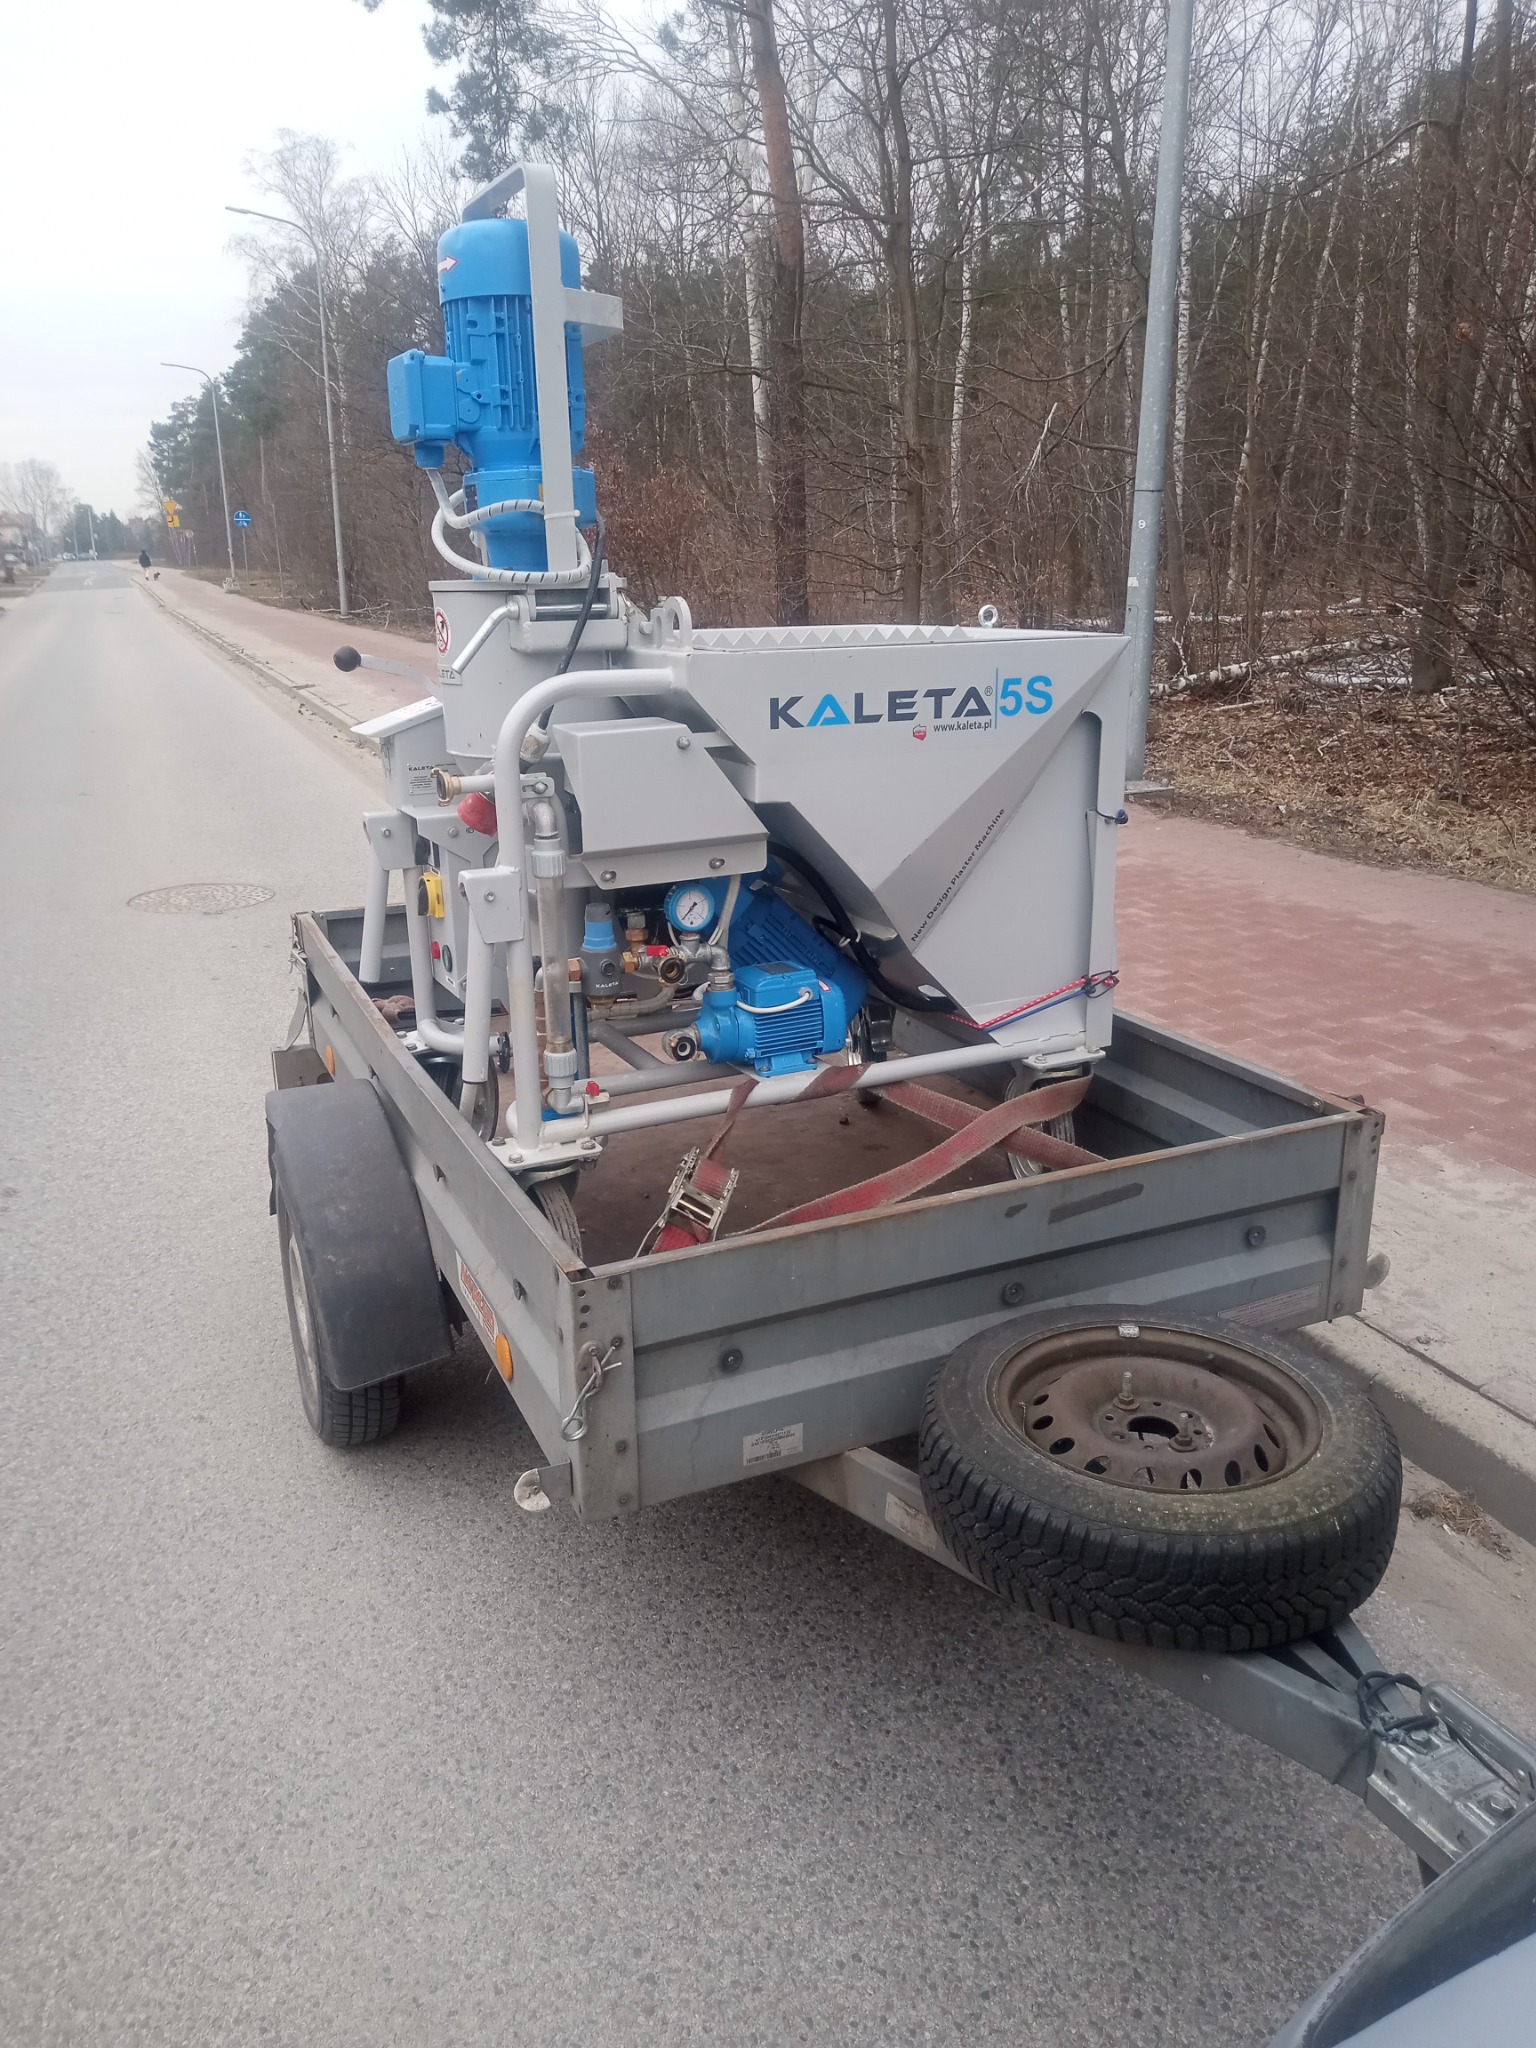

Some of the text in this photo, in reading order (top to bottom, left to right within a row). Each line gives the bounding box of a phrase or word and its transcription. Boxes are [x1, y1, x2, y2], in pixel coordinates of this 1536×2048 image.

[999, 675, 1053, 717] 5S
[933, 719, 992, 732] www.kaleta.pl
[911, 808, 1005, 942] New Design Plaster Machine
